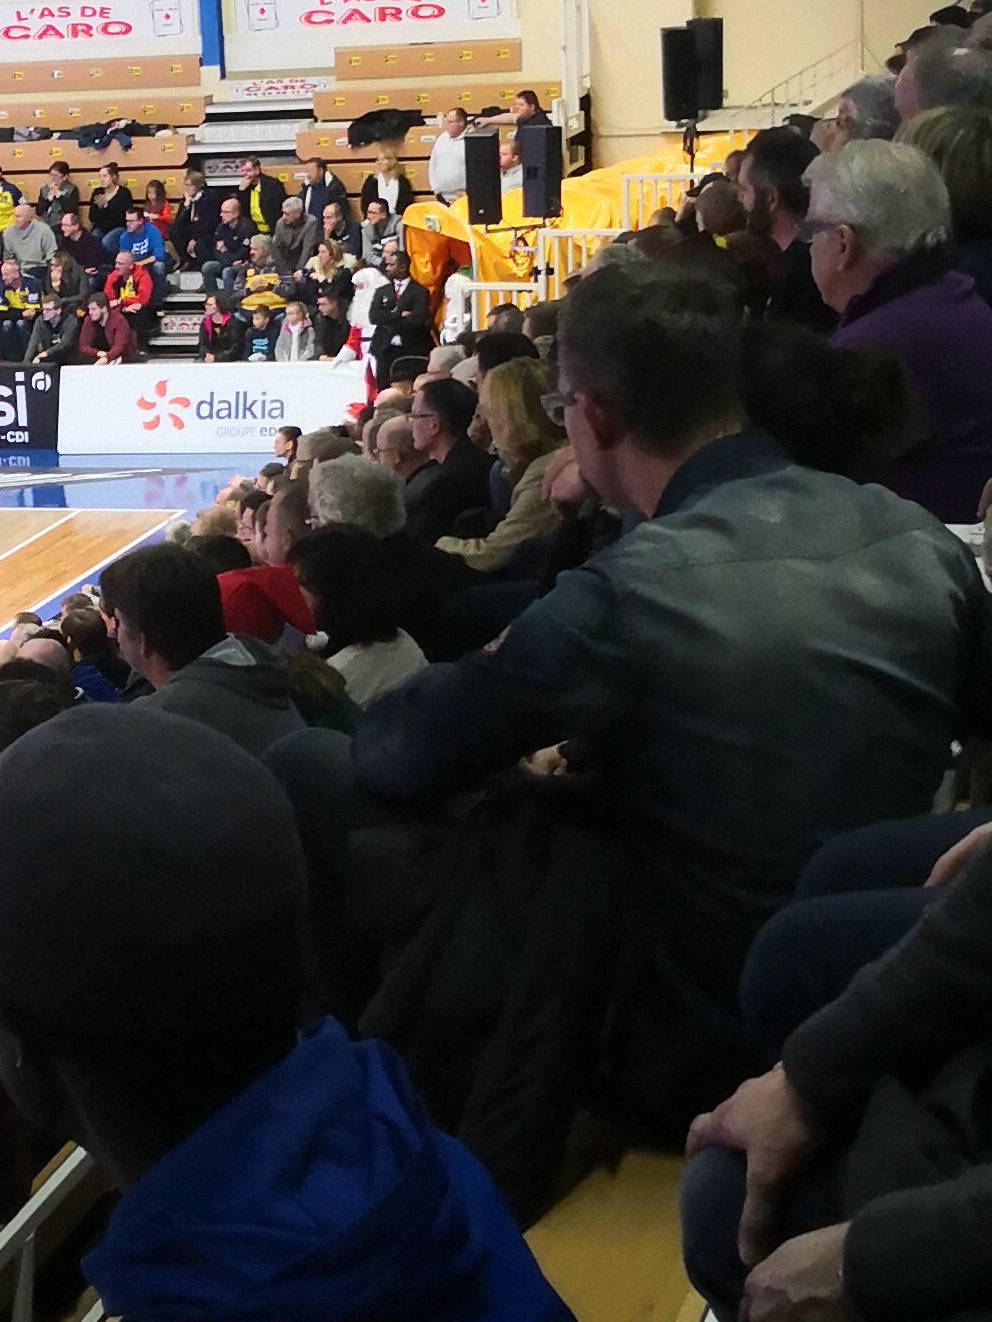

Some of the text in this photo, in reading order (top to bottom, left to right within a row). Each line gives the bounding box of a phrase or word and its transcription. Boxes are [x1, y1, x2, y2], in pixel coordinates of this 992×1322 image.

[16, 6, 112, 22] L'AS DE
[300, 3, 446, 26] CARO
[0, 21, 133, 41] CARO
[195, 391, 285, 420] dalkia
[216, 426, 256, 438] GROUPE
